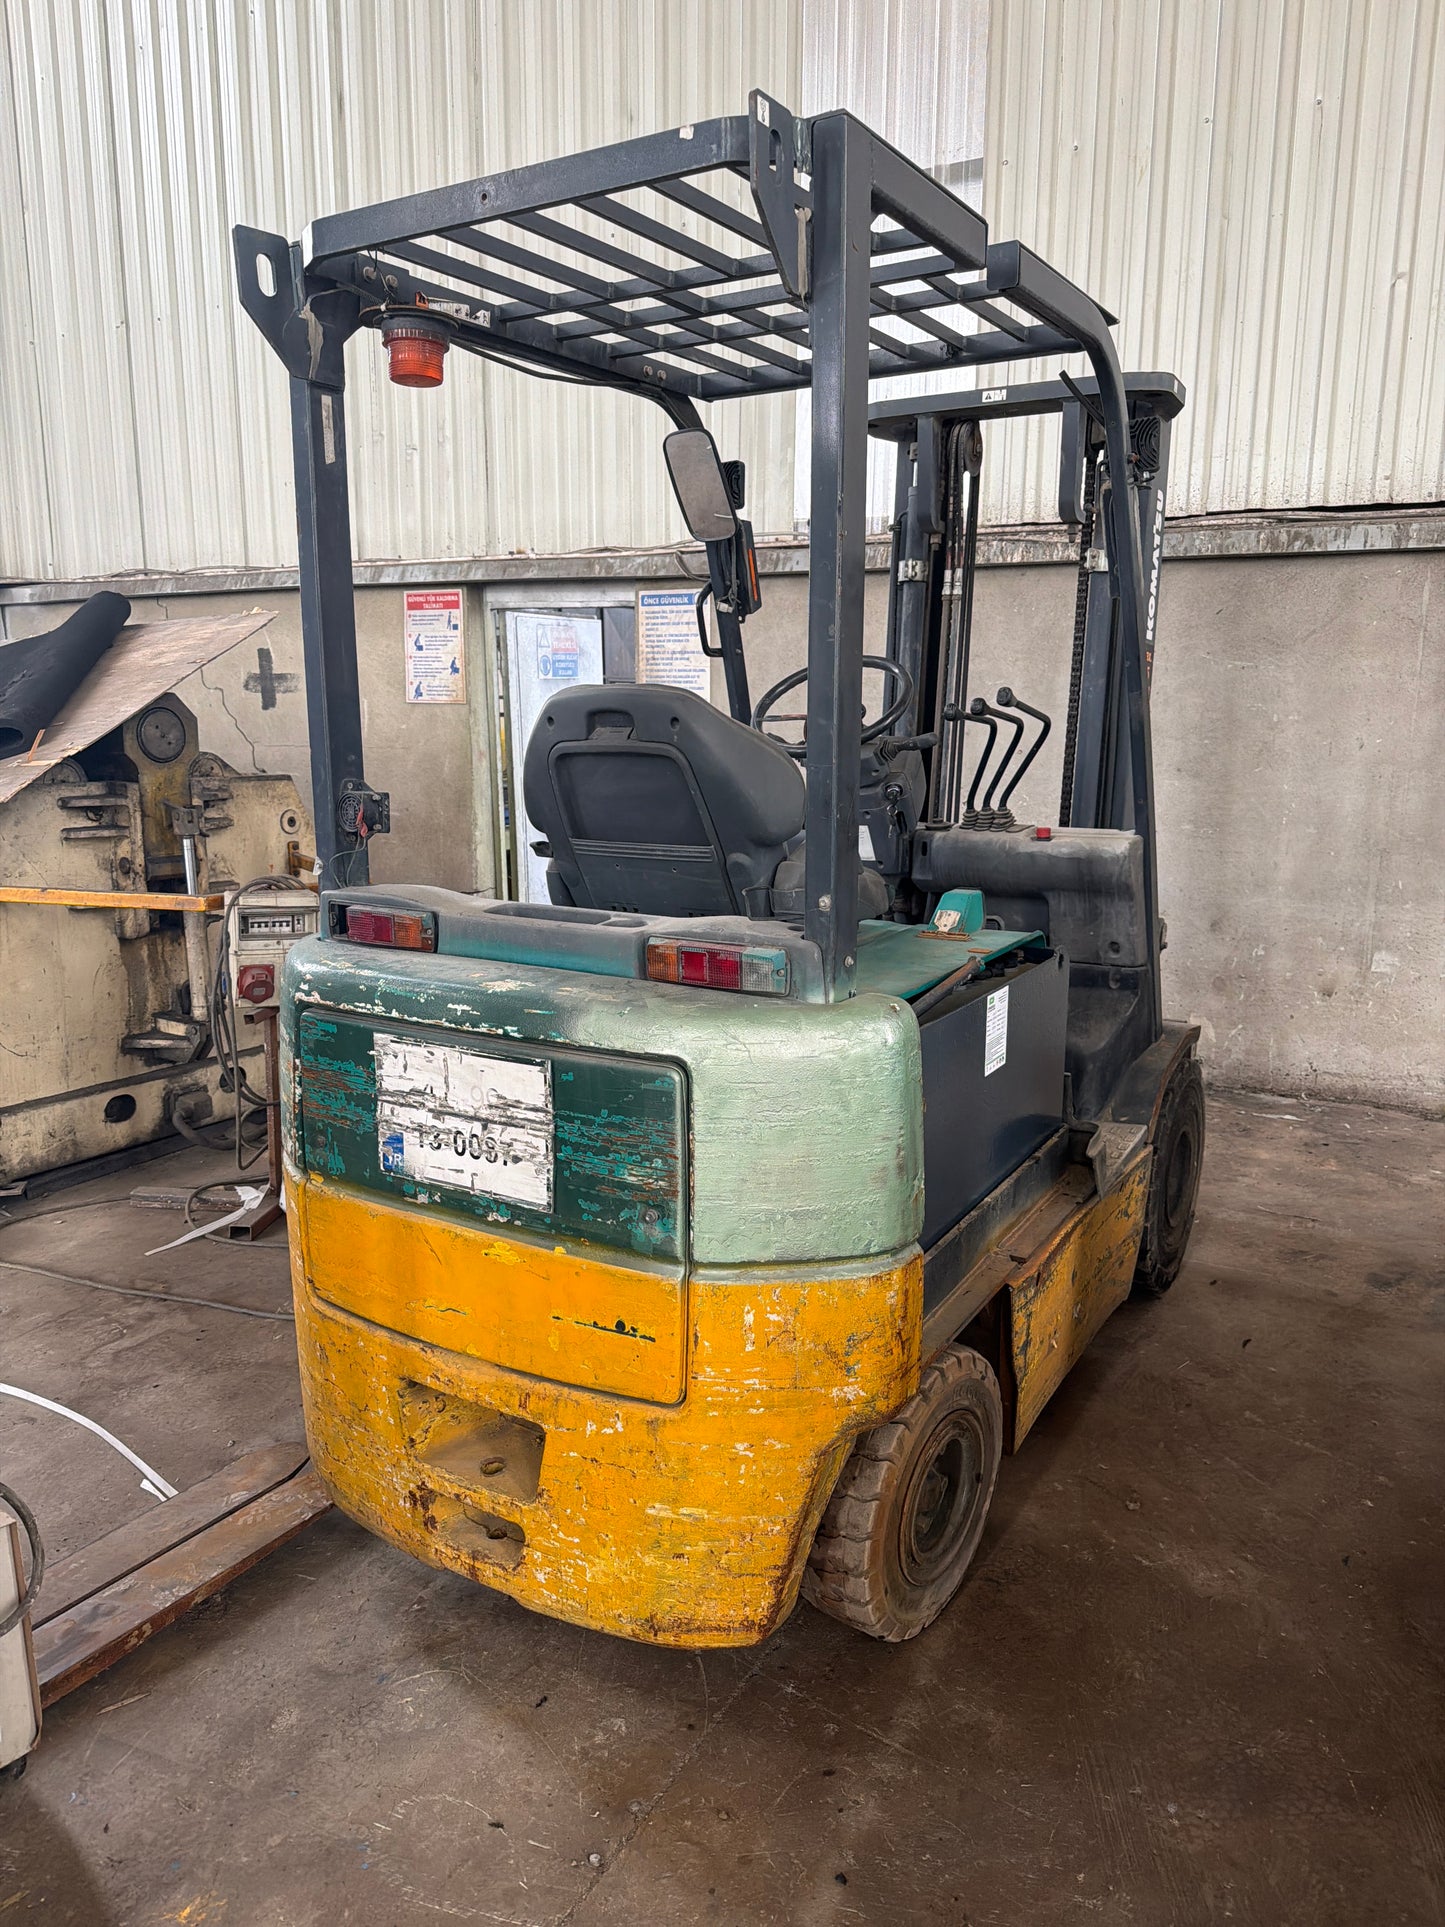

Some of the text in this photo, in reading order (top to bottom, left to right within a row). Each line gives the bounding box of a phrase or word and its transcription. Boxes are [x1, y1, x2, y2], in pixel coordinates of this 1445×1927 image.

[643, 595, 689, 605] ÖNCE GÜVENLİK
[1146, 490, 1164, 641] KOMATSU
